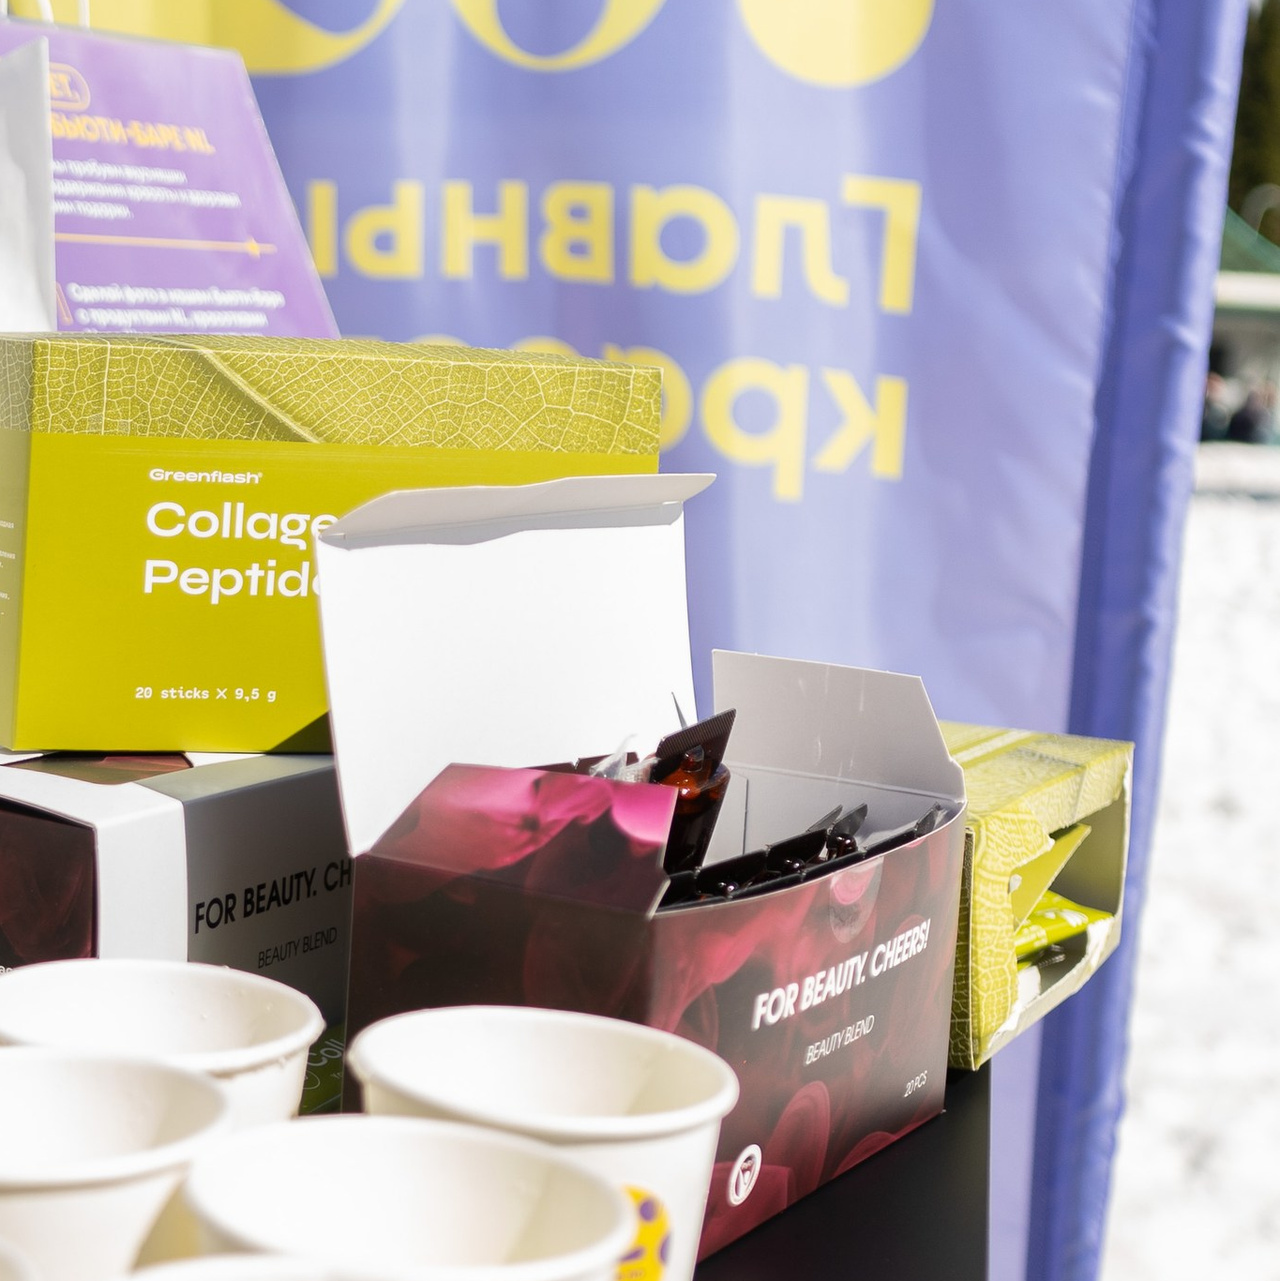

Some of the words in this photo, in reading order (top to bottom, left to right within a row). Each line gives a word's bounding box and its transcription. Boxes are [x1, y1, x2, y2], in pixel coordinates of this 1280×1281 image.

[146, 501, 339, 551] Collage
[143, 559, 320, 606] Peptid
[135, 686, 153, 700] 20
[160, 686, 210, 701] sticks
[234, 686, 260, 703] 9,5
[266, 689, 277, 703] g
[195, 893, 237, 935] FOR
[243, 867, 318, 919] BEAUTY.
[258, 939, 301, 969] BEAUTY
[303, 926, 338, 954] BLEND
[751, 982, 800, 1032] FOR
[800, 951, 869, 1011] BEAUTY.
[870, 918, 932, 978] CHEERS!
[805, 1030, 846, 1066] BEAUTY
[844, 1015, 875, 1045] BLEND
[904, 1079, 915, 1098] 20
[913, 1070, 928, 1092] PCS
